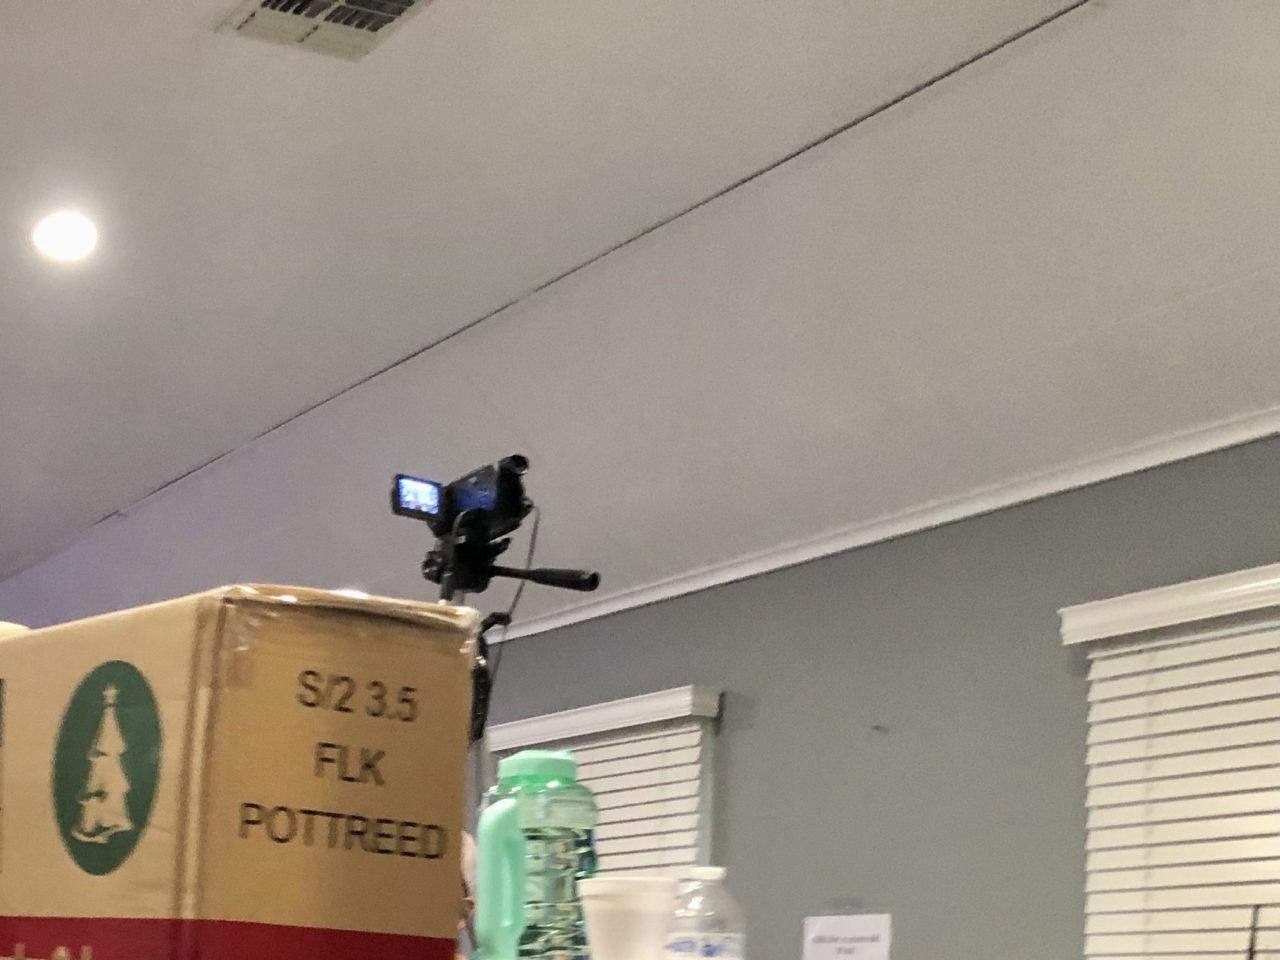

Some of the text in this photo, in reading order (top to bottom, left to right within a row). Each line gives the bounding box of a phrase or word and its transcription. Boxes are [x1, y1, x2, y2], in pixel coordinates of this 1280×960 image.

[295, 669, 418, 722] S/2 3.5
[313, 742, 386, 786] FLK
[238, 802, 450, 860] POTTREED
